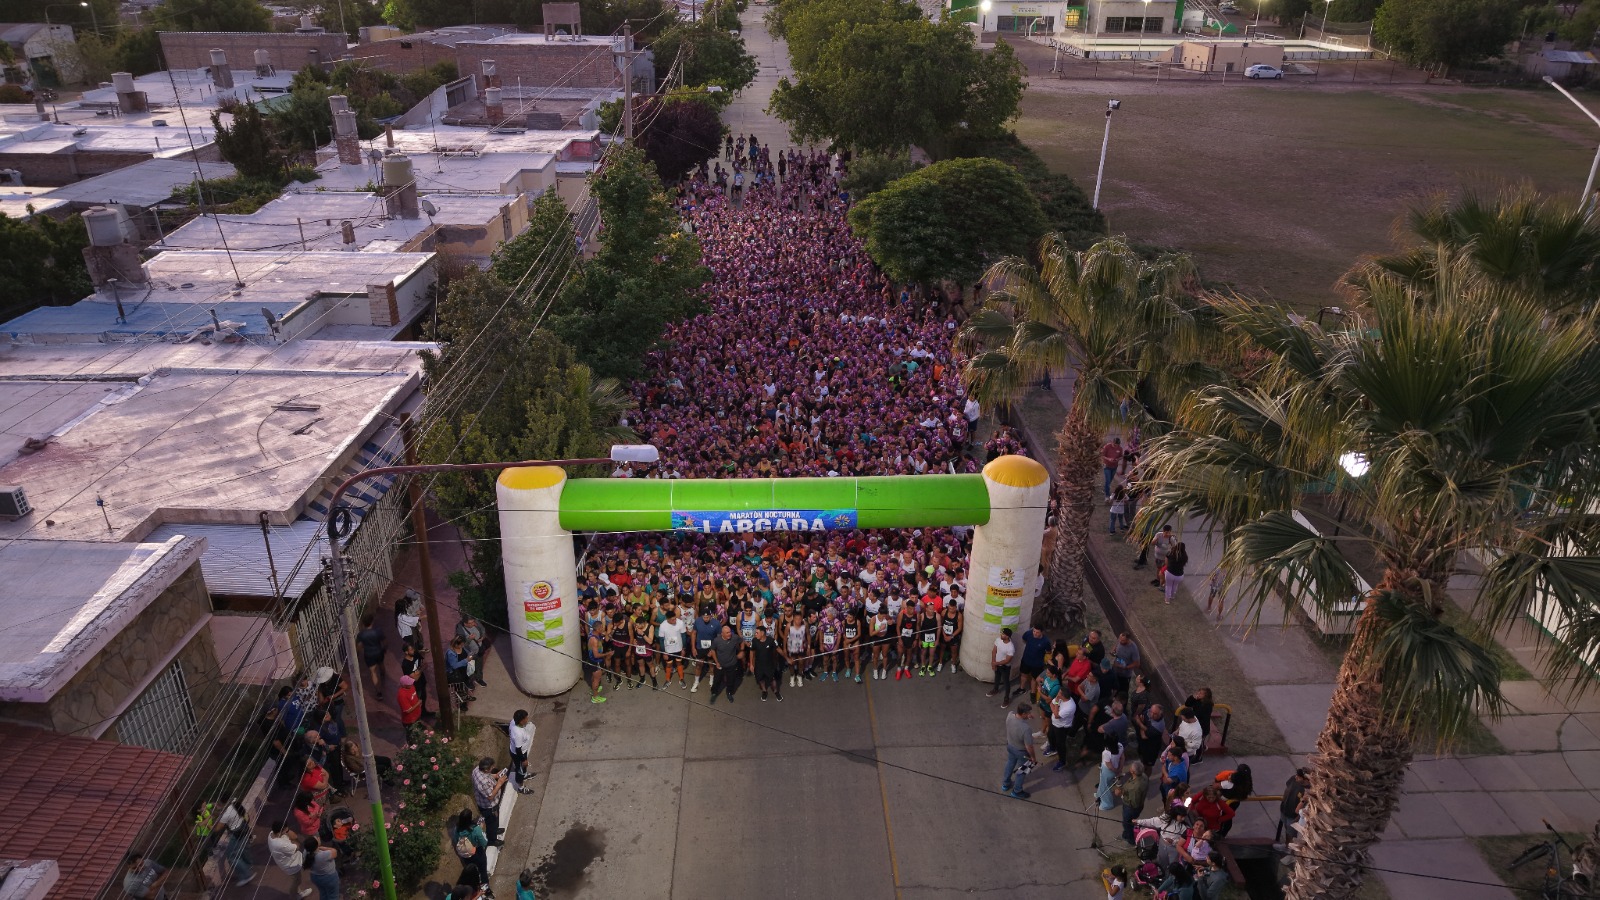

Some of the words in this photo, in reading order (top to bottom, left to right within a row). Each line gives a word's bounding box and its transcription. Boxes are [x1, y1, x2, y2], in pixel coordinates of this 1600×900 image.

[729, 510, 763, 519] MARATÓN
[764, 511, 801, 519] NOCTURNA
[702, 518, 826, 533] LARGADA
